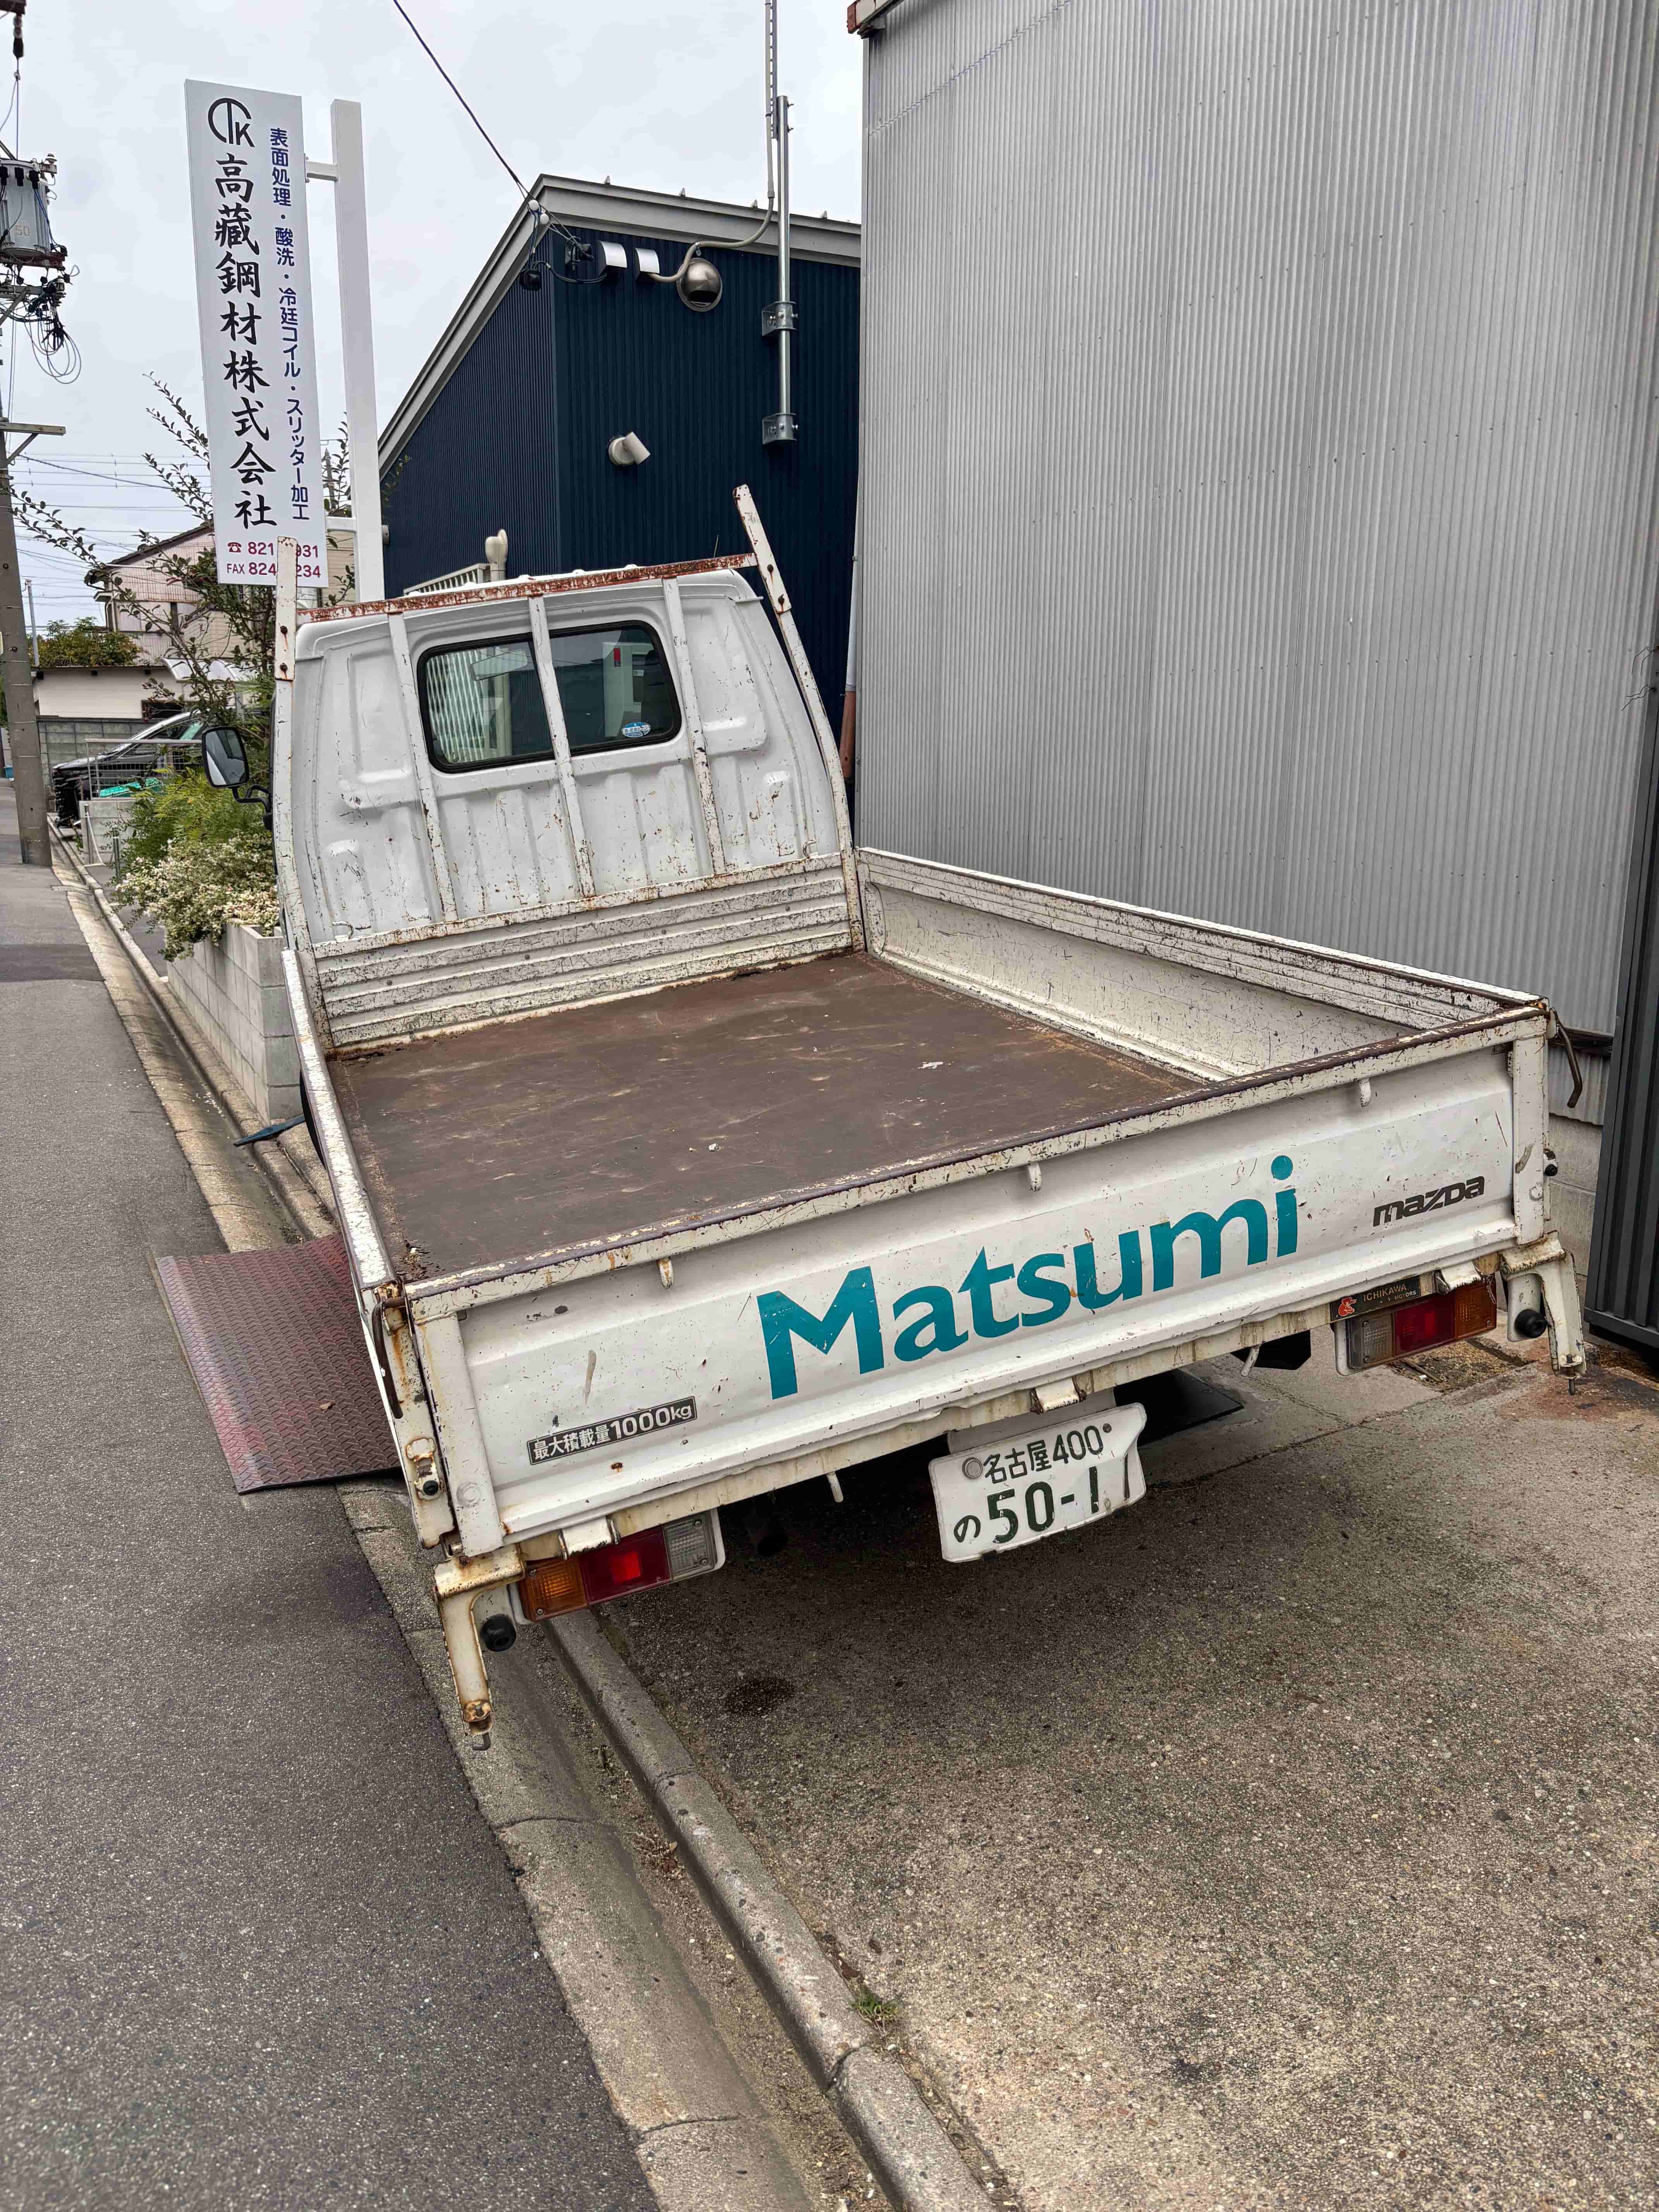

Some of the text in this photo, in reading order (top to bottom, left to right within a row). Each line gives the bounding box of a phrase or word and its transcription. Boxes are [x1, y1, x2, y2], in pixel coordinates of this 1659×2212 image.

[227, 563, 245, 574] FAX
[1373, 1176, 1485, 1227] mazda
[757, 1155, 1298, 1400] Matsumi
[1363, 1283, 1407, 1302] ICHIKAWA
[1394, 1290, 1416, 1300] MOTORS
[954, 1515, 981, 1543] の
